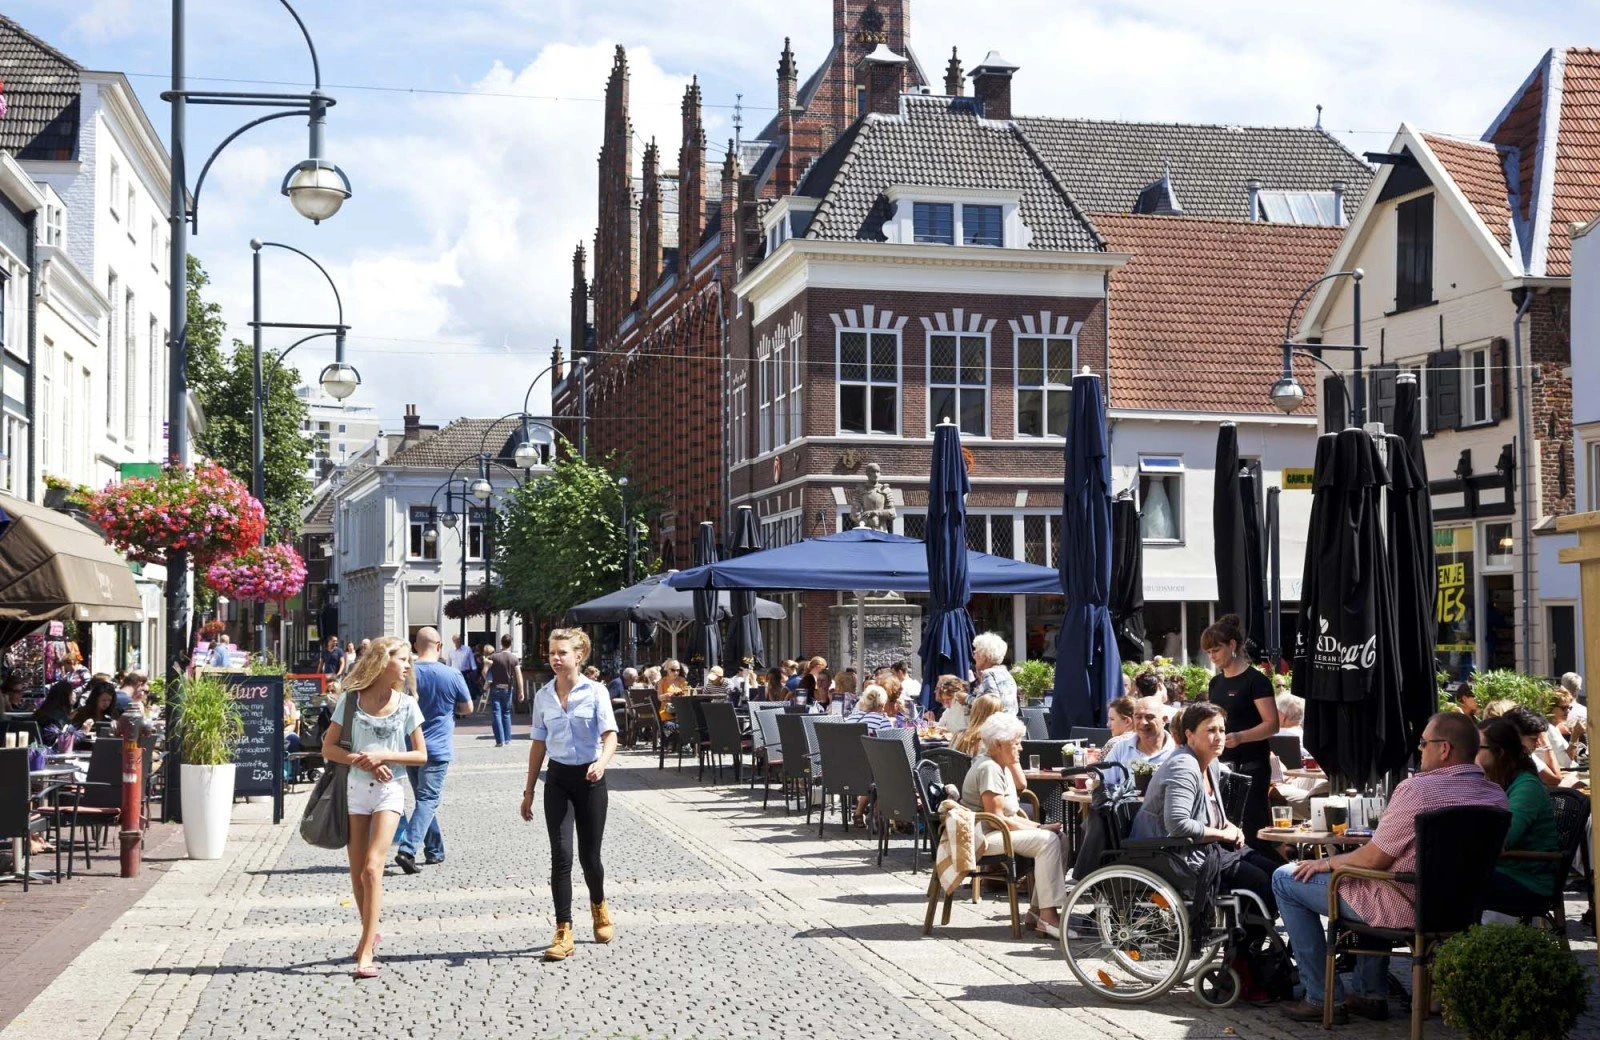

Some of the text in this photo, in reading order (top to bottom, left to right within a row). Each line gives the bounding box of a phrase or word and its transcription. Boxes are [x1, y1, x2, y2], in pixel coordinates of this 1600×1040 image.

[1439, 566, 1463, 584] EN JE
[1438, 588, 1466, 623] ES
[252, 769, 274, 782] 5,25
